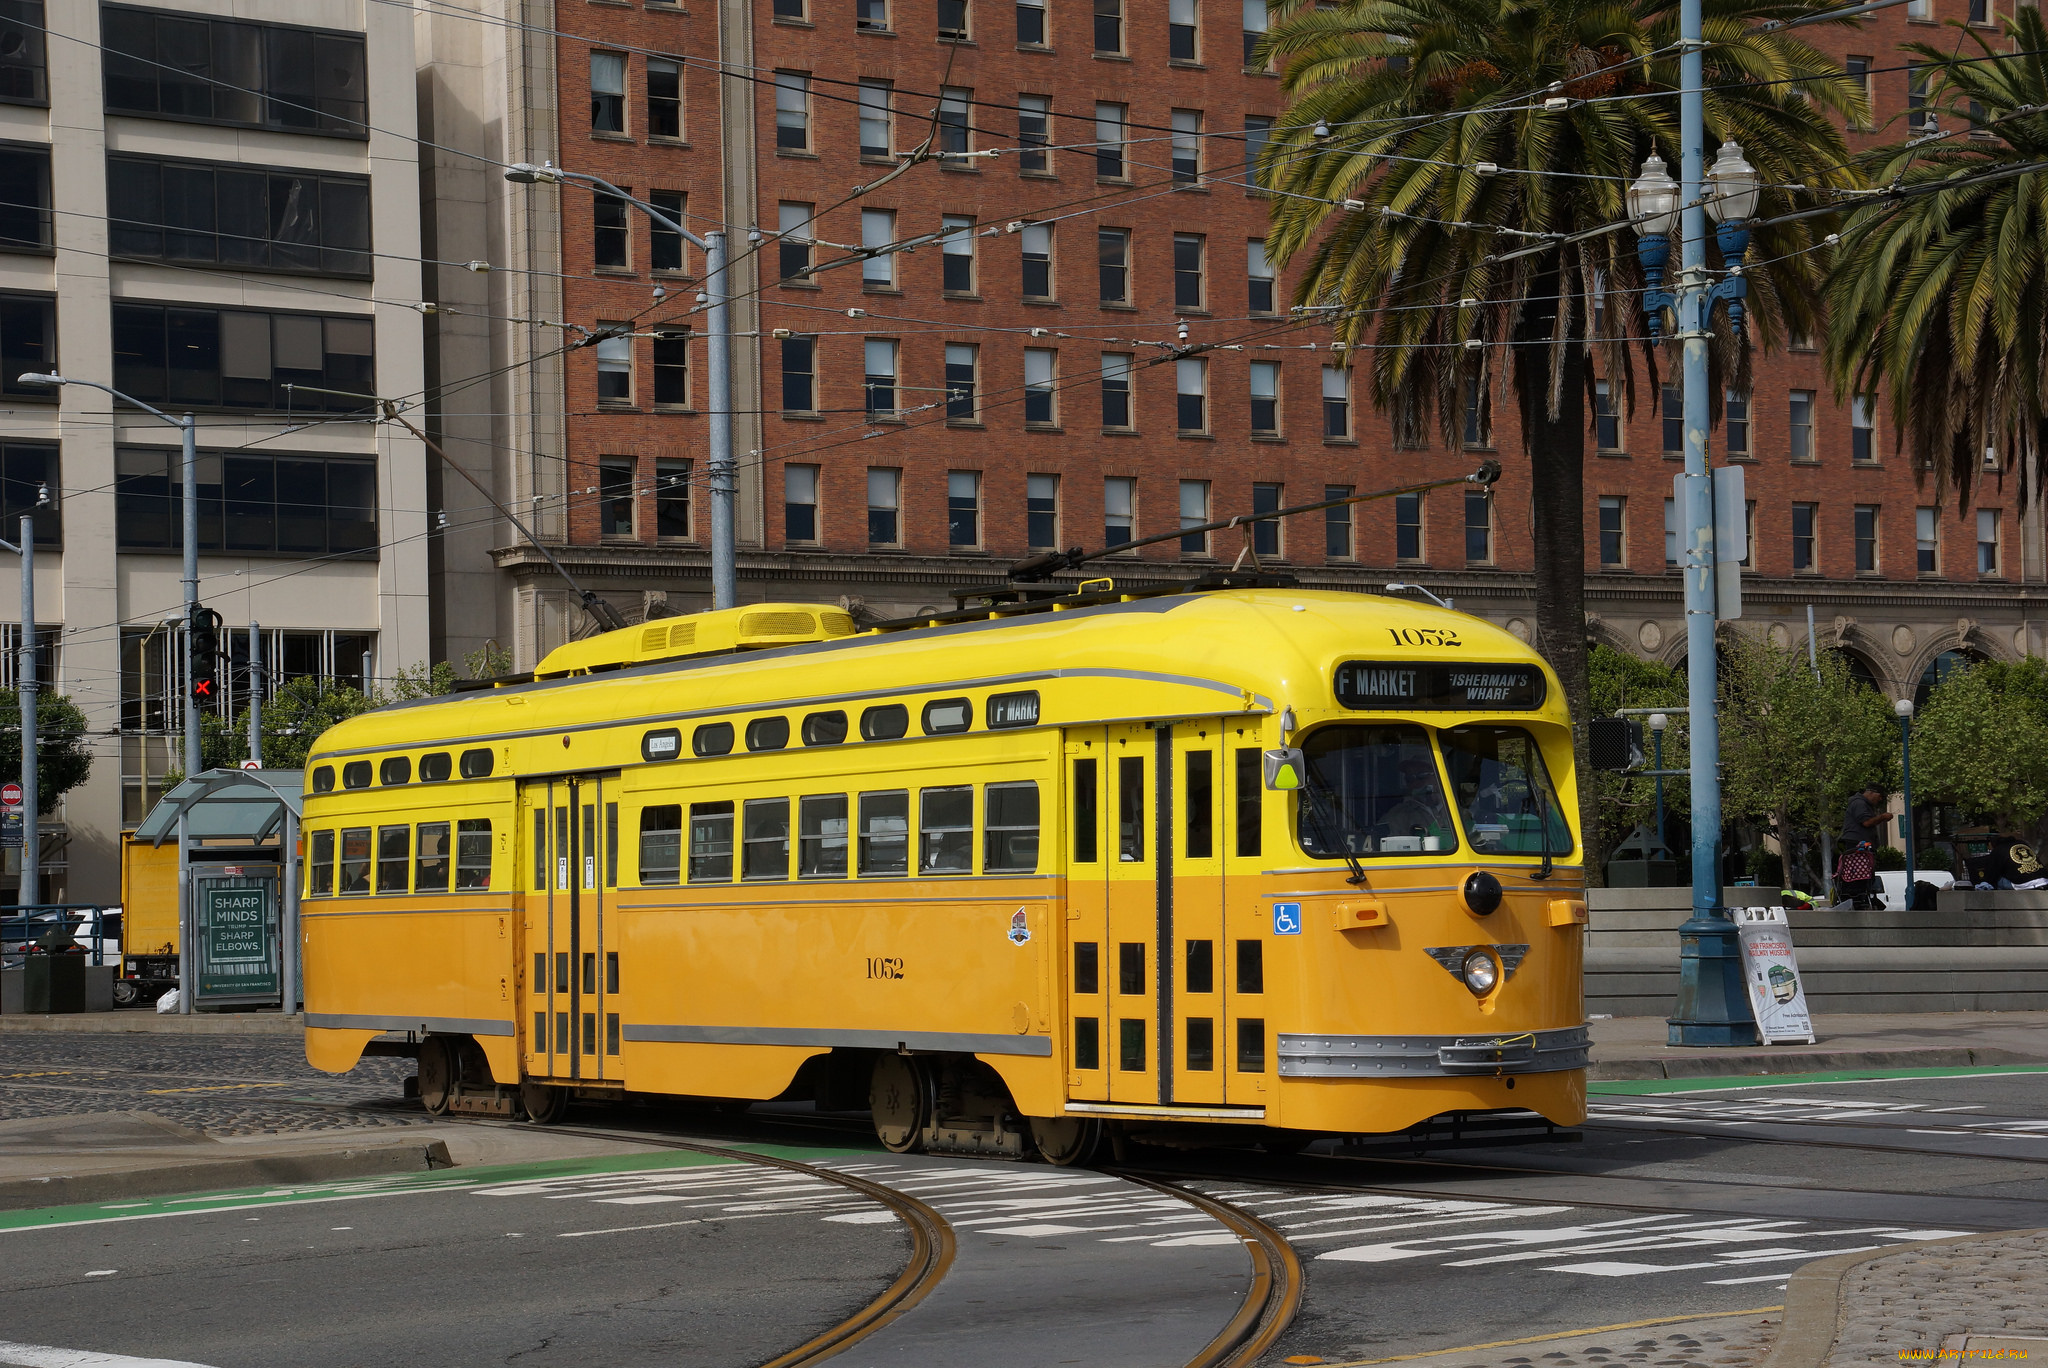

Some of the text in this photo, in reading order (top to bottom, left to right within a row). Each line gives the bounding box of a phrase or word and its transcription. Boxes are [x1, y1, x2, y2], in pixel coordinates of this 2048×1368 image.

[1384, 627, 1463, 648] 1052
[1338, 668, 1417, 697] F MARKET
[1466, 687, 1511, 701] WHARF
[215, 897, 260, 909] SHARP
[216, 910, 258, 922] MINDS
[220, 931, 255, 941] SHARP
[216, 942, 261, 951] ELBOWS.
[866, 957, 904, 980] 1052
